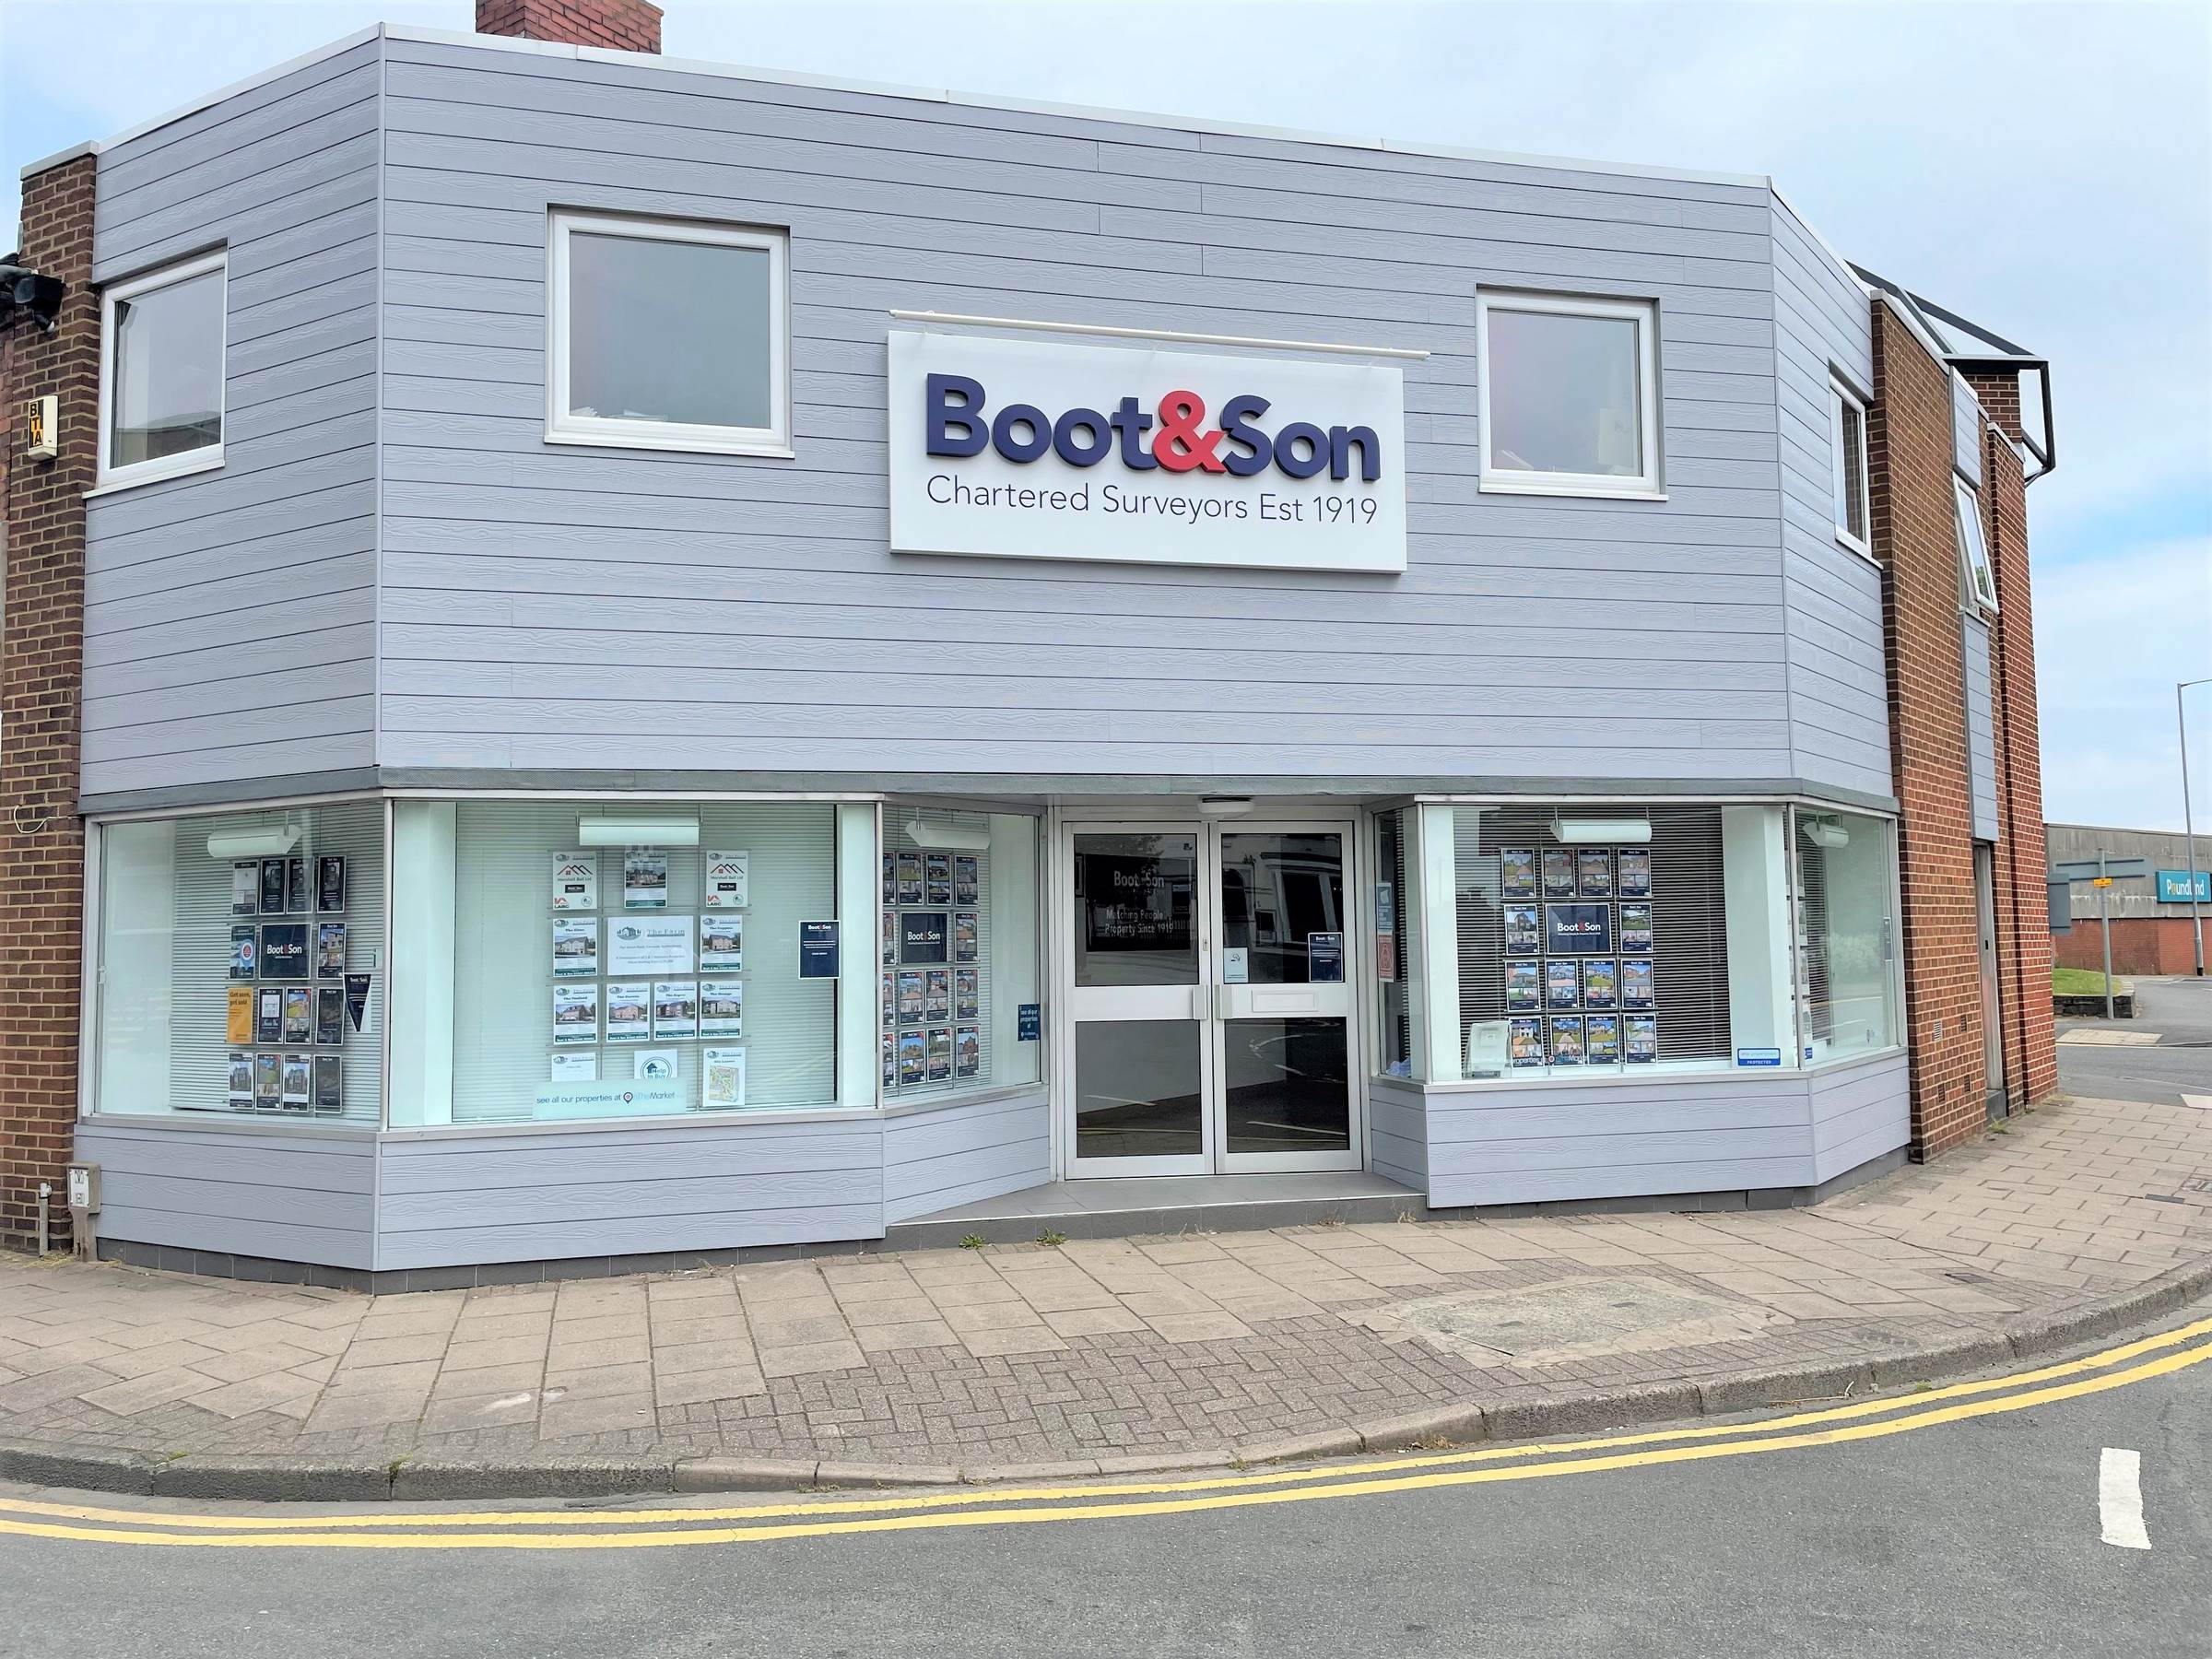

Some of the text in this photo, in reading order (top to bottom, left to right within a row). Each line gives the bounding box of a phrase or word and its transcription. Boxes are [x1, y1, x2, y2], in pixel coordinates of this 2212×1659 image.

[926, 372, 1382, 482] Boot&Son
[926, 475, 1378, 525] Chartered Surveyors Est 1919
[1113, 870, 1165, 888] BootSon
[2166, 878, 2205, 896] Poundlnd
[1104, 924, 1136, 936] Property
[1137, 923, 1156, 934] Since
[575, 1094, 613, 1104] properties
